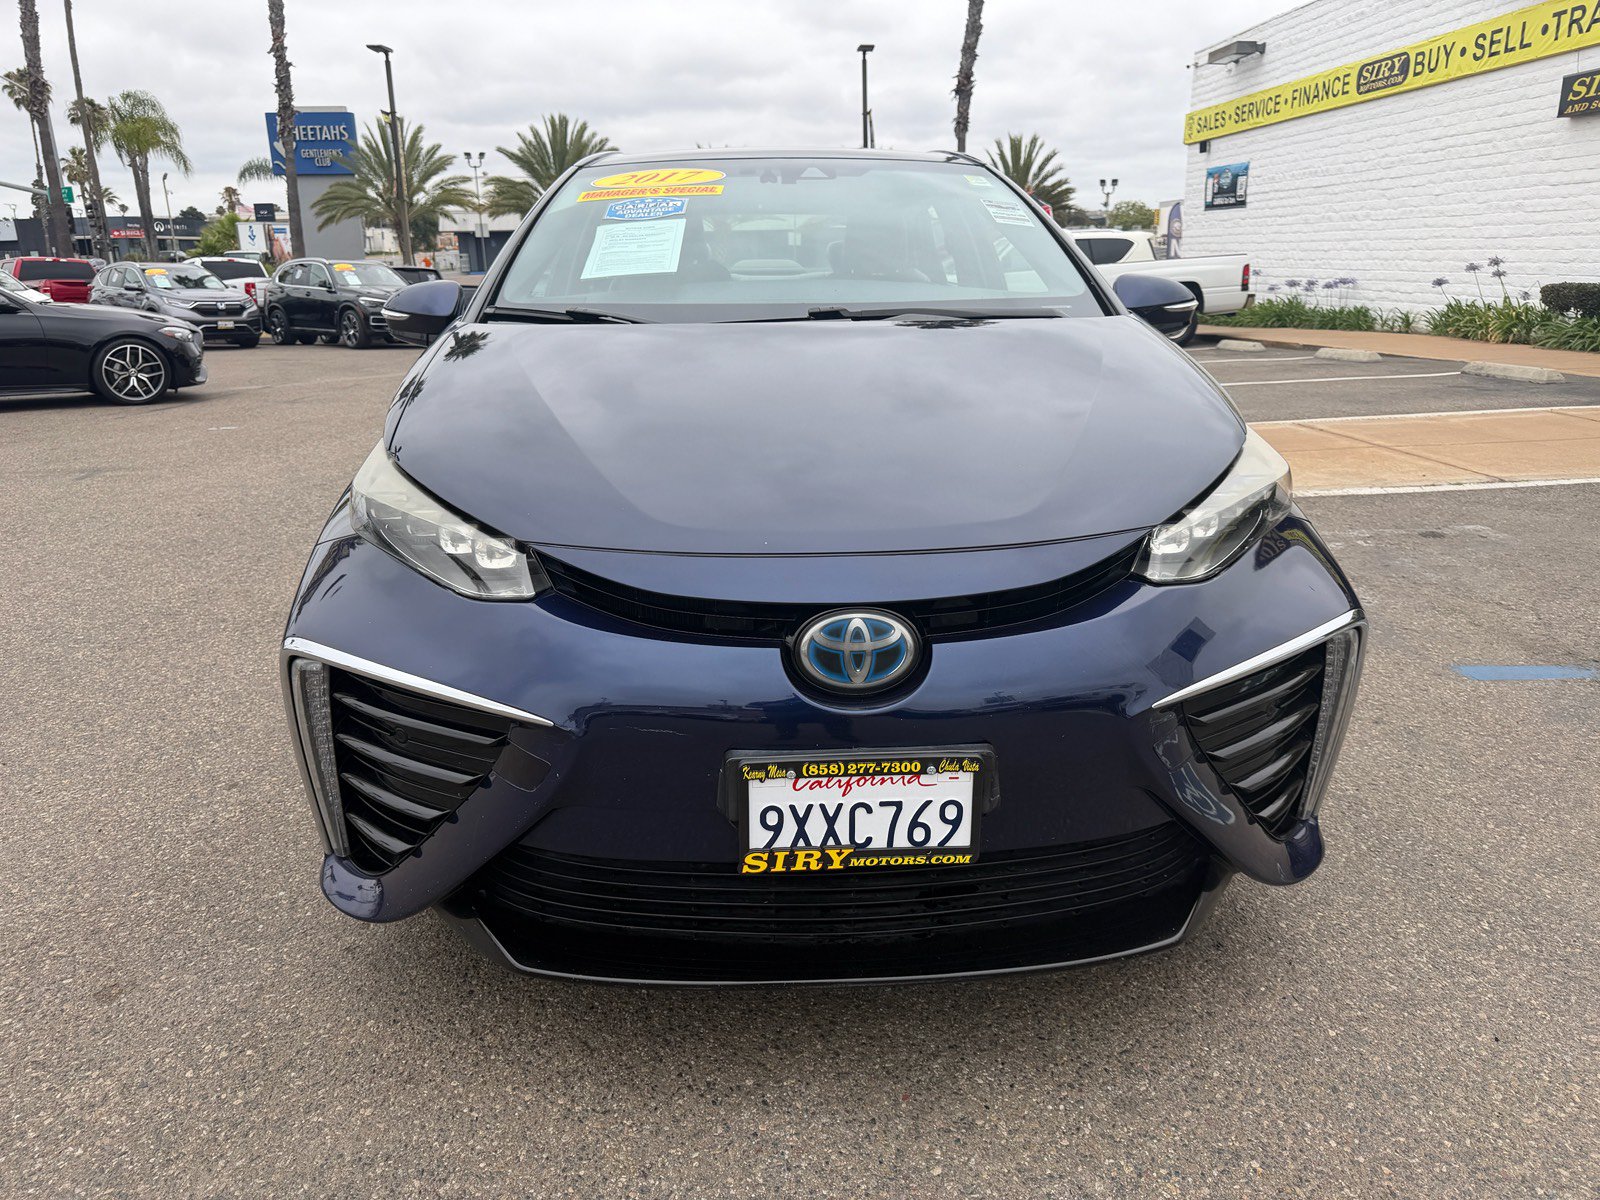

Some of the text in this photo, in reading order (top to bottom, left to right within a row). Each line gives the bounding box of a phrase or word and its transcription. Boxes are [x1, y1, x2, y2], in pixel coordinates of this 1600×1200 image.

[1412, 41, 1456, 77] BUY
[1472, 21, 1532, 61] SELL
[1360, 54, 1407, 84] SIRY
[1567, 74, 1600, 101] SI
[1196, 110, 1226, 133] SALES
[1233, 94, 1281, 124] SERVICE
[1290, 73, 1351, 109] FINANCE
[1564, 102, 1589, 114] AND
[291, 125, 349, 141] HEETAHS
[315, 157, 332, 167] CLUB
[611, 172, 704, 185] 2017
[582, 186, 718, 200] MANAGER'S SPECIAL
[616, 206, 675, 215] ADVANTAGE
[742, 764, 786, 782] Kearny Mesa
[802, 761, 921, 777] (858) 277-7300
[939, 758, 979, 773] Chula Vista
[792, 774, 937, 797] California
[759, 799, 964, 850] 9XXC769
[742, 848, 972, 873] SIRY MOTORS.COM
